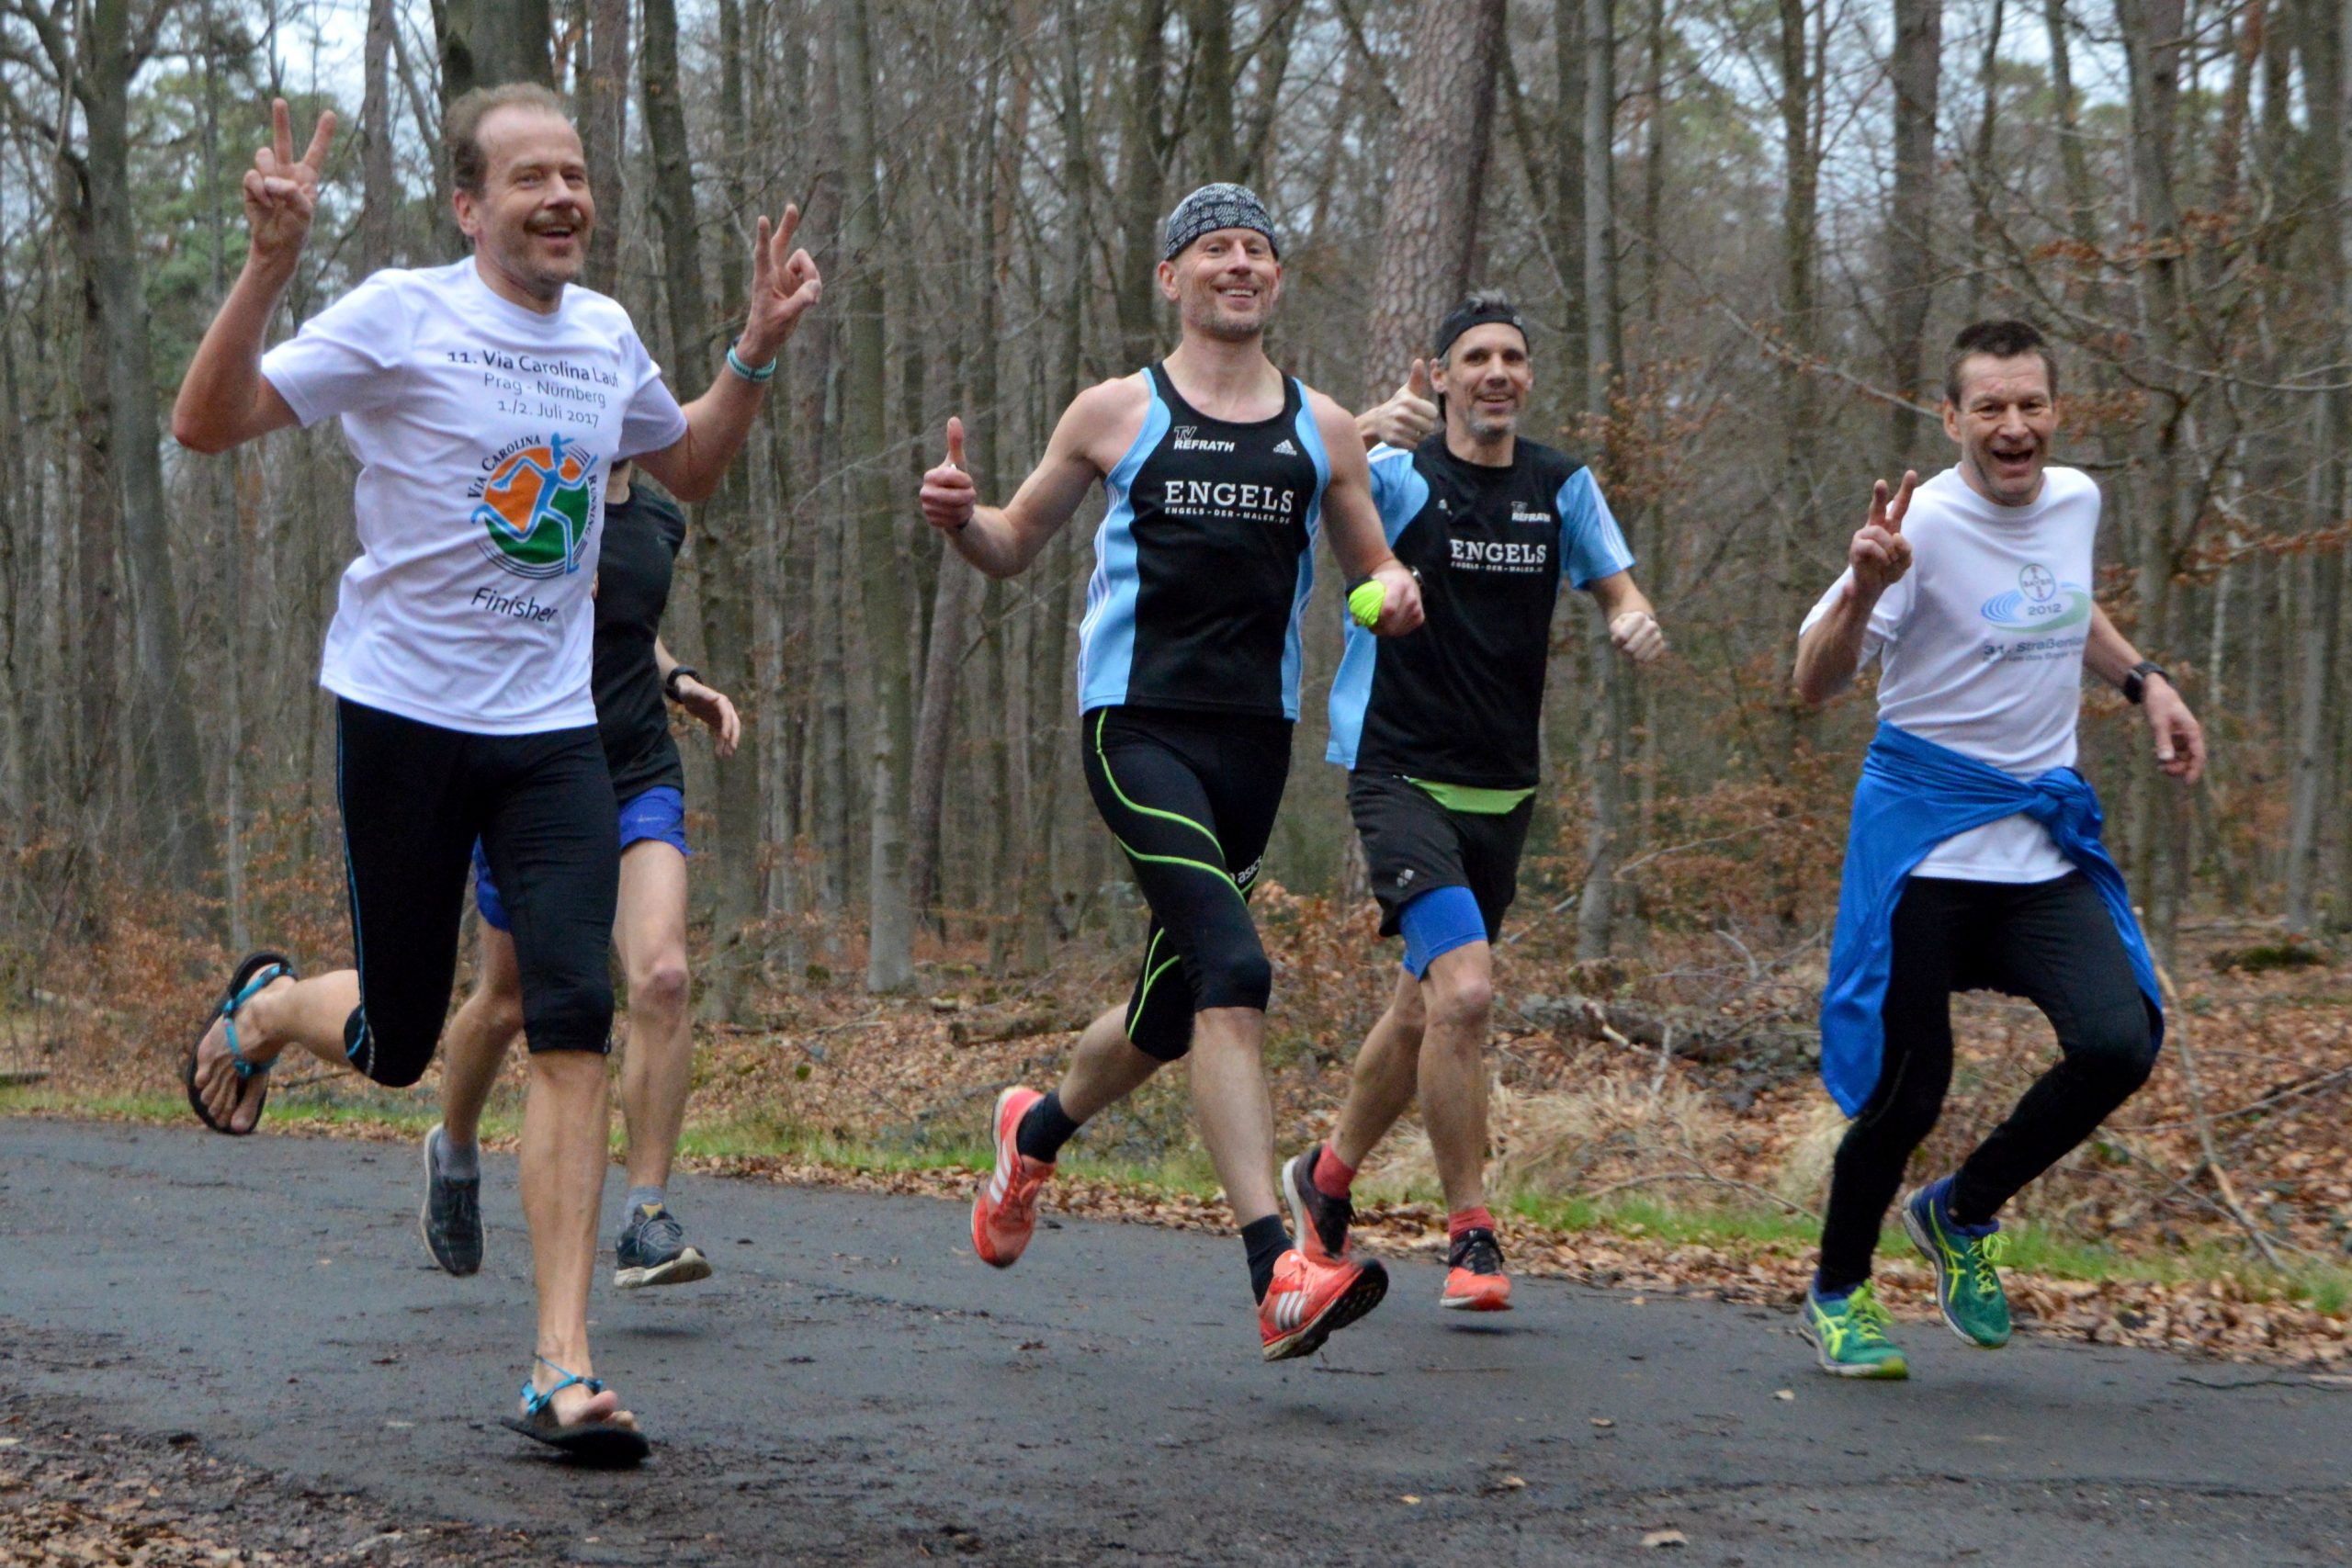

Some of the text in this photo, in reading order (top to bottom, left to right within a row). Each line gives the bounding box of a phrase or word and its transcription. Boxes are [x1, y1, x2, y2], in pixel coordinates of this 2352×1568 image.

[447, 351, 477, 364] 11.
[482, 350, 514, 369] Via
[519, 355, 590, 380] Carolina
[484, 372, 522, 395] Prag
[537, 380, 606, 407] Nürnberg
[497, 400, 599, 428] 1./2. Juli 2017
[1173, 439, 1236, 453] REFRATH
[468, 434, 541, 500] VIA CAROLINA
[585, 474, 598, 536] RUNNING
[1164, 480, 1295, 513] ENGELS
[1450, 538, 1547, 564] ENGELS
[471, 587, 558, 623] Finisher
[2028, 604, 2062, 616] 2012
